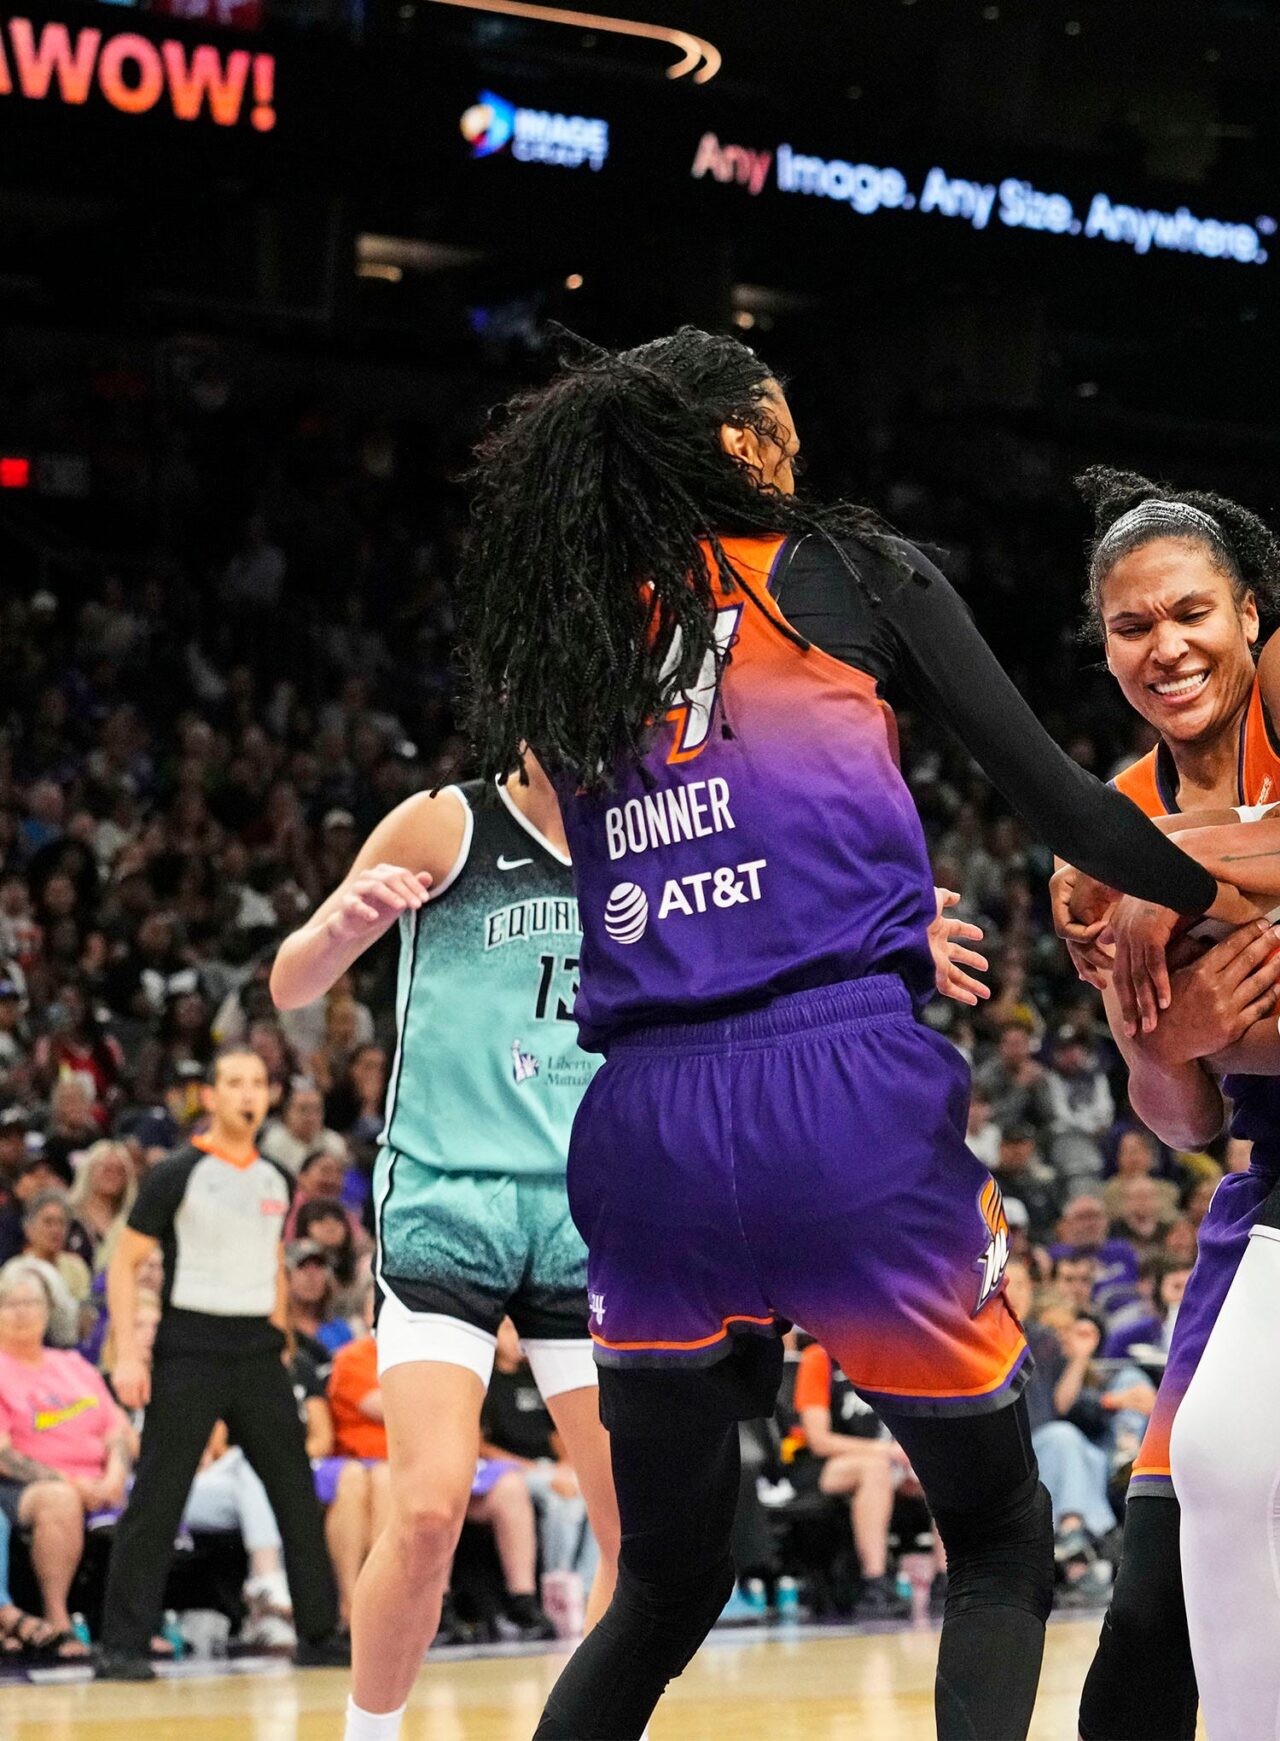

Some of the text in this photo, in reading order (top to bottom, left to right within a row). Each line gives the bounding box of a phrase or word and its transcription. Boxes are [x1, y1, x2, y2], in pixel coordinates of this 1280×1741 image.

[10, 16, 277, 132] WOW!
[691, 131, 771, 195] Any
[776, 143, 916, 214] Image.
[920, 166, 997, 230] Any
[999, 177, 1082, 235] Size.
[605, 777, 736, 861] BONNER
[486, 898, 583, 950] EQUA
[657, 858, 767, 920] AT&T
